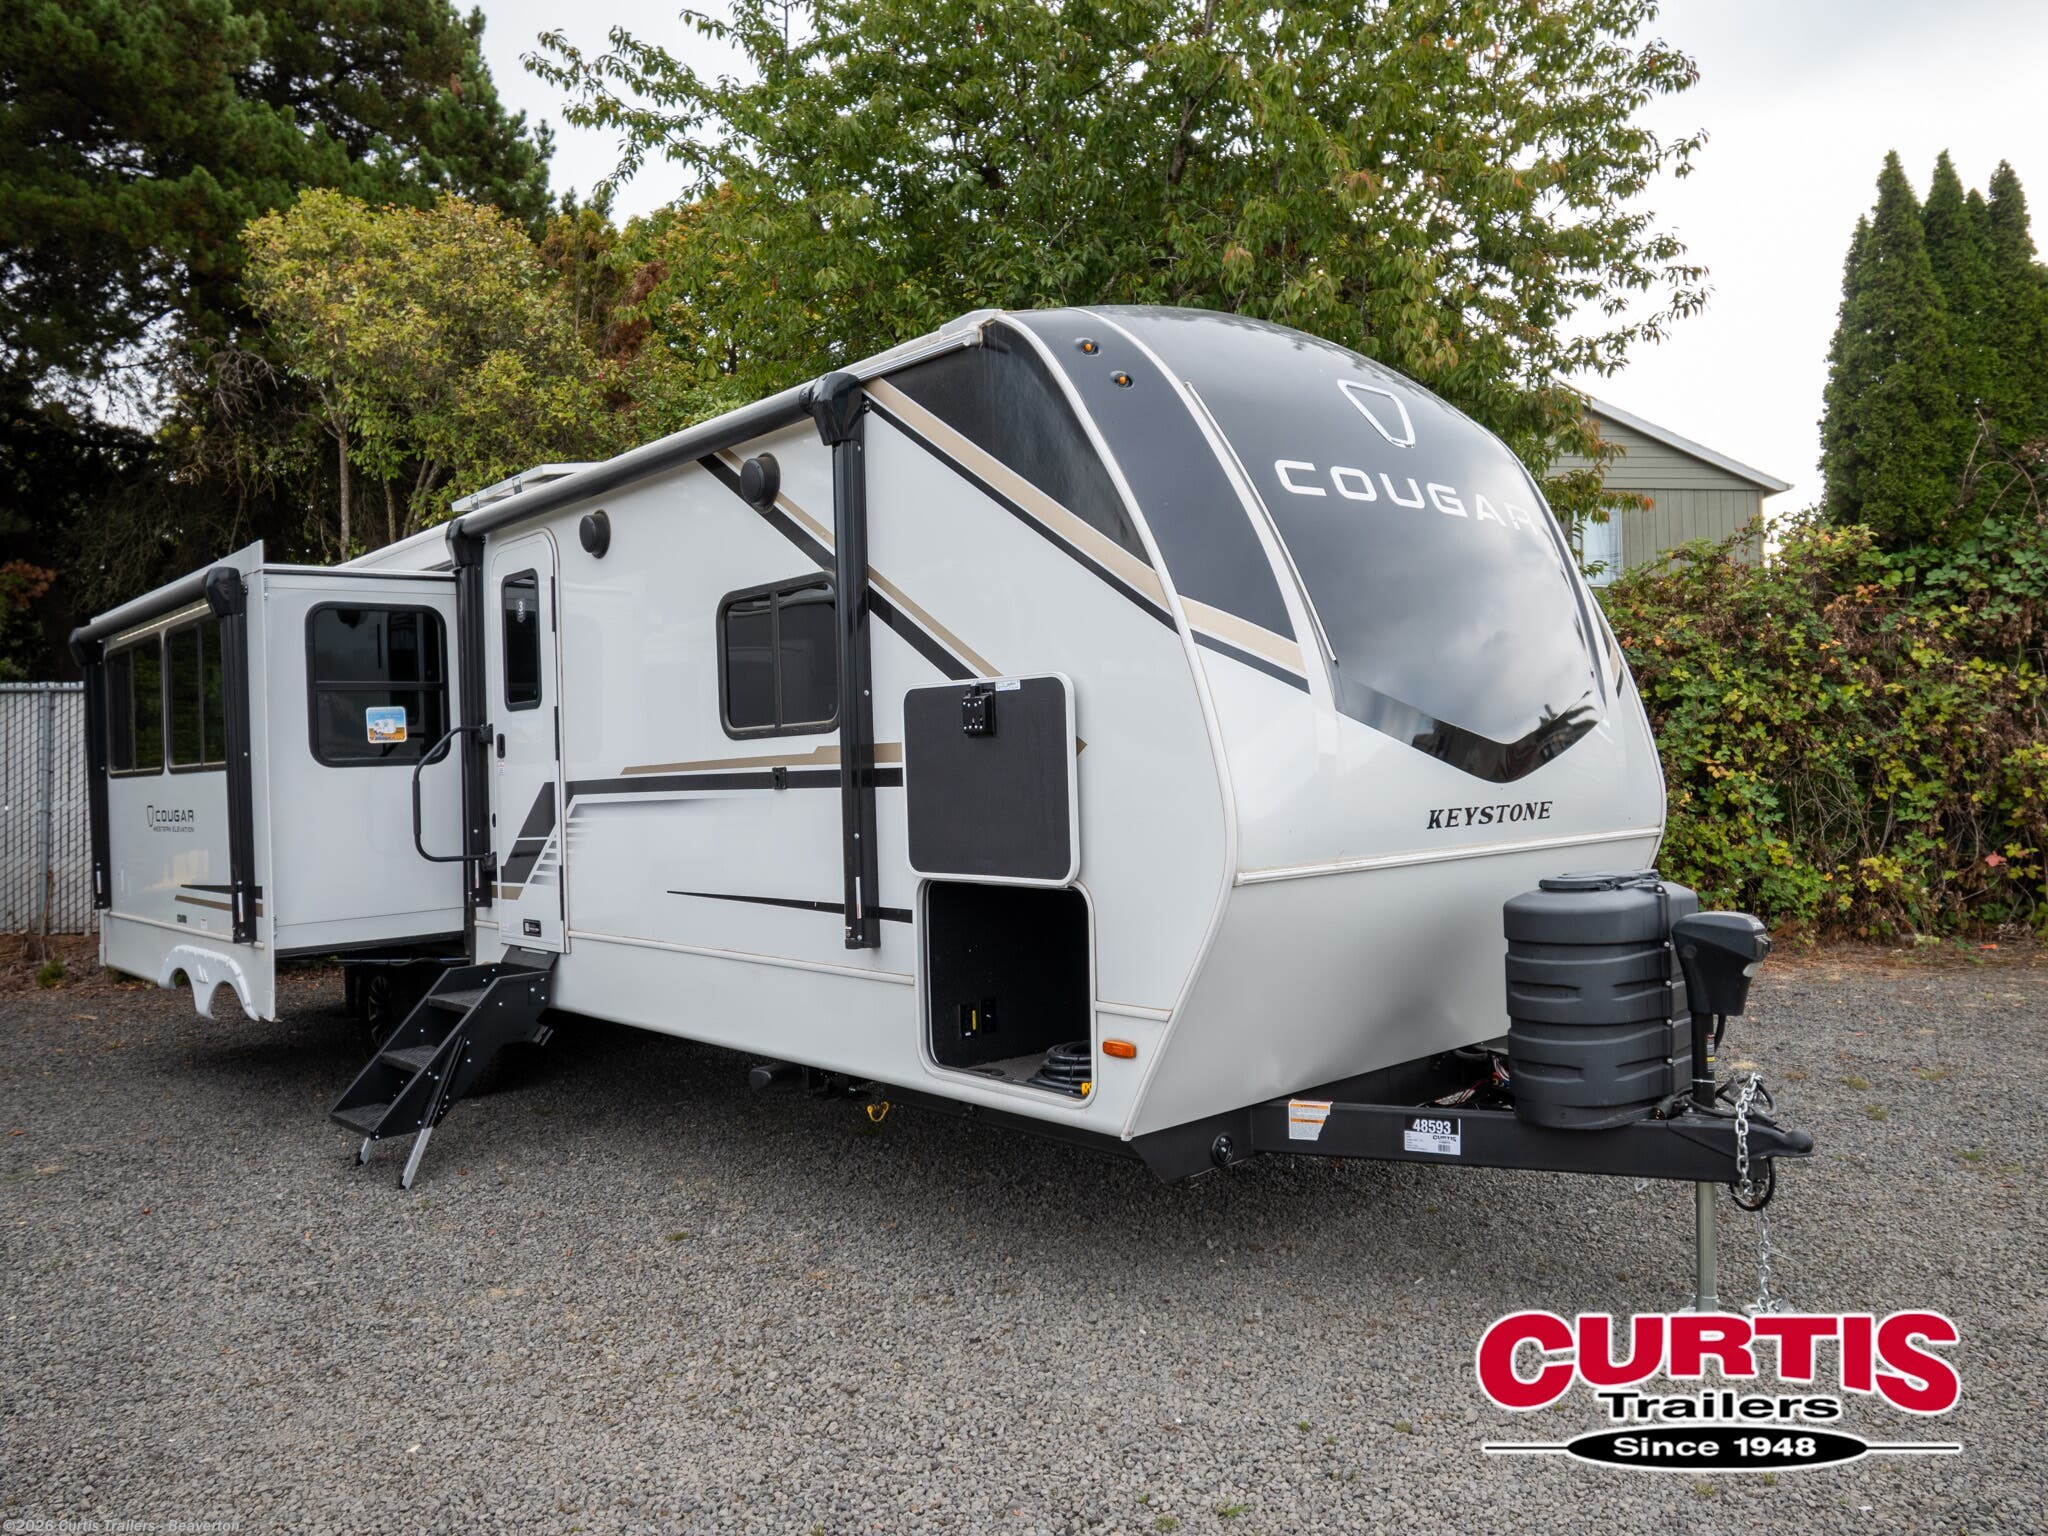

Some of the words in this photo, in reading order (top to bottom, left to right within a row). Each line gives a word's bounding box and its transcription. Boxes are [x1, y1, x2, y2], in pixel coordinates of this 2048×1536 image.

[1274, 459, 1539, 536] COUGAR
[155, 809, 194, 822] COUGAR
[1426, 800, 1553, 830] KEYSTONE
[1412, 1118, 1452, 1135] 48593
